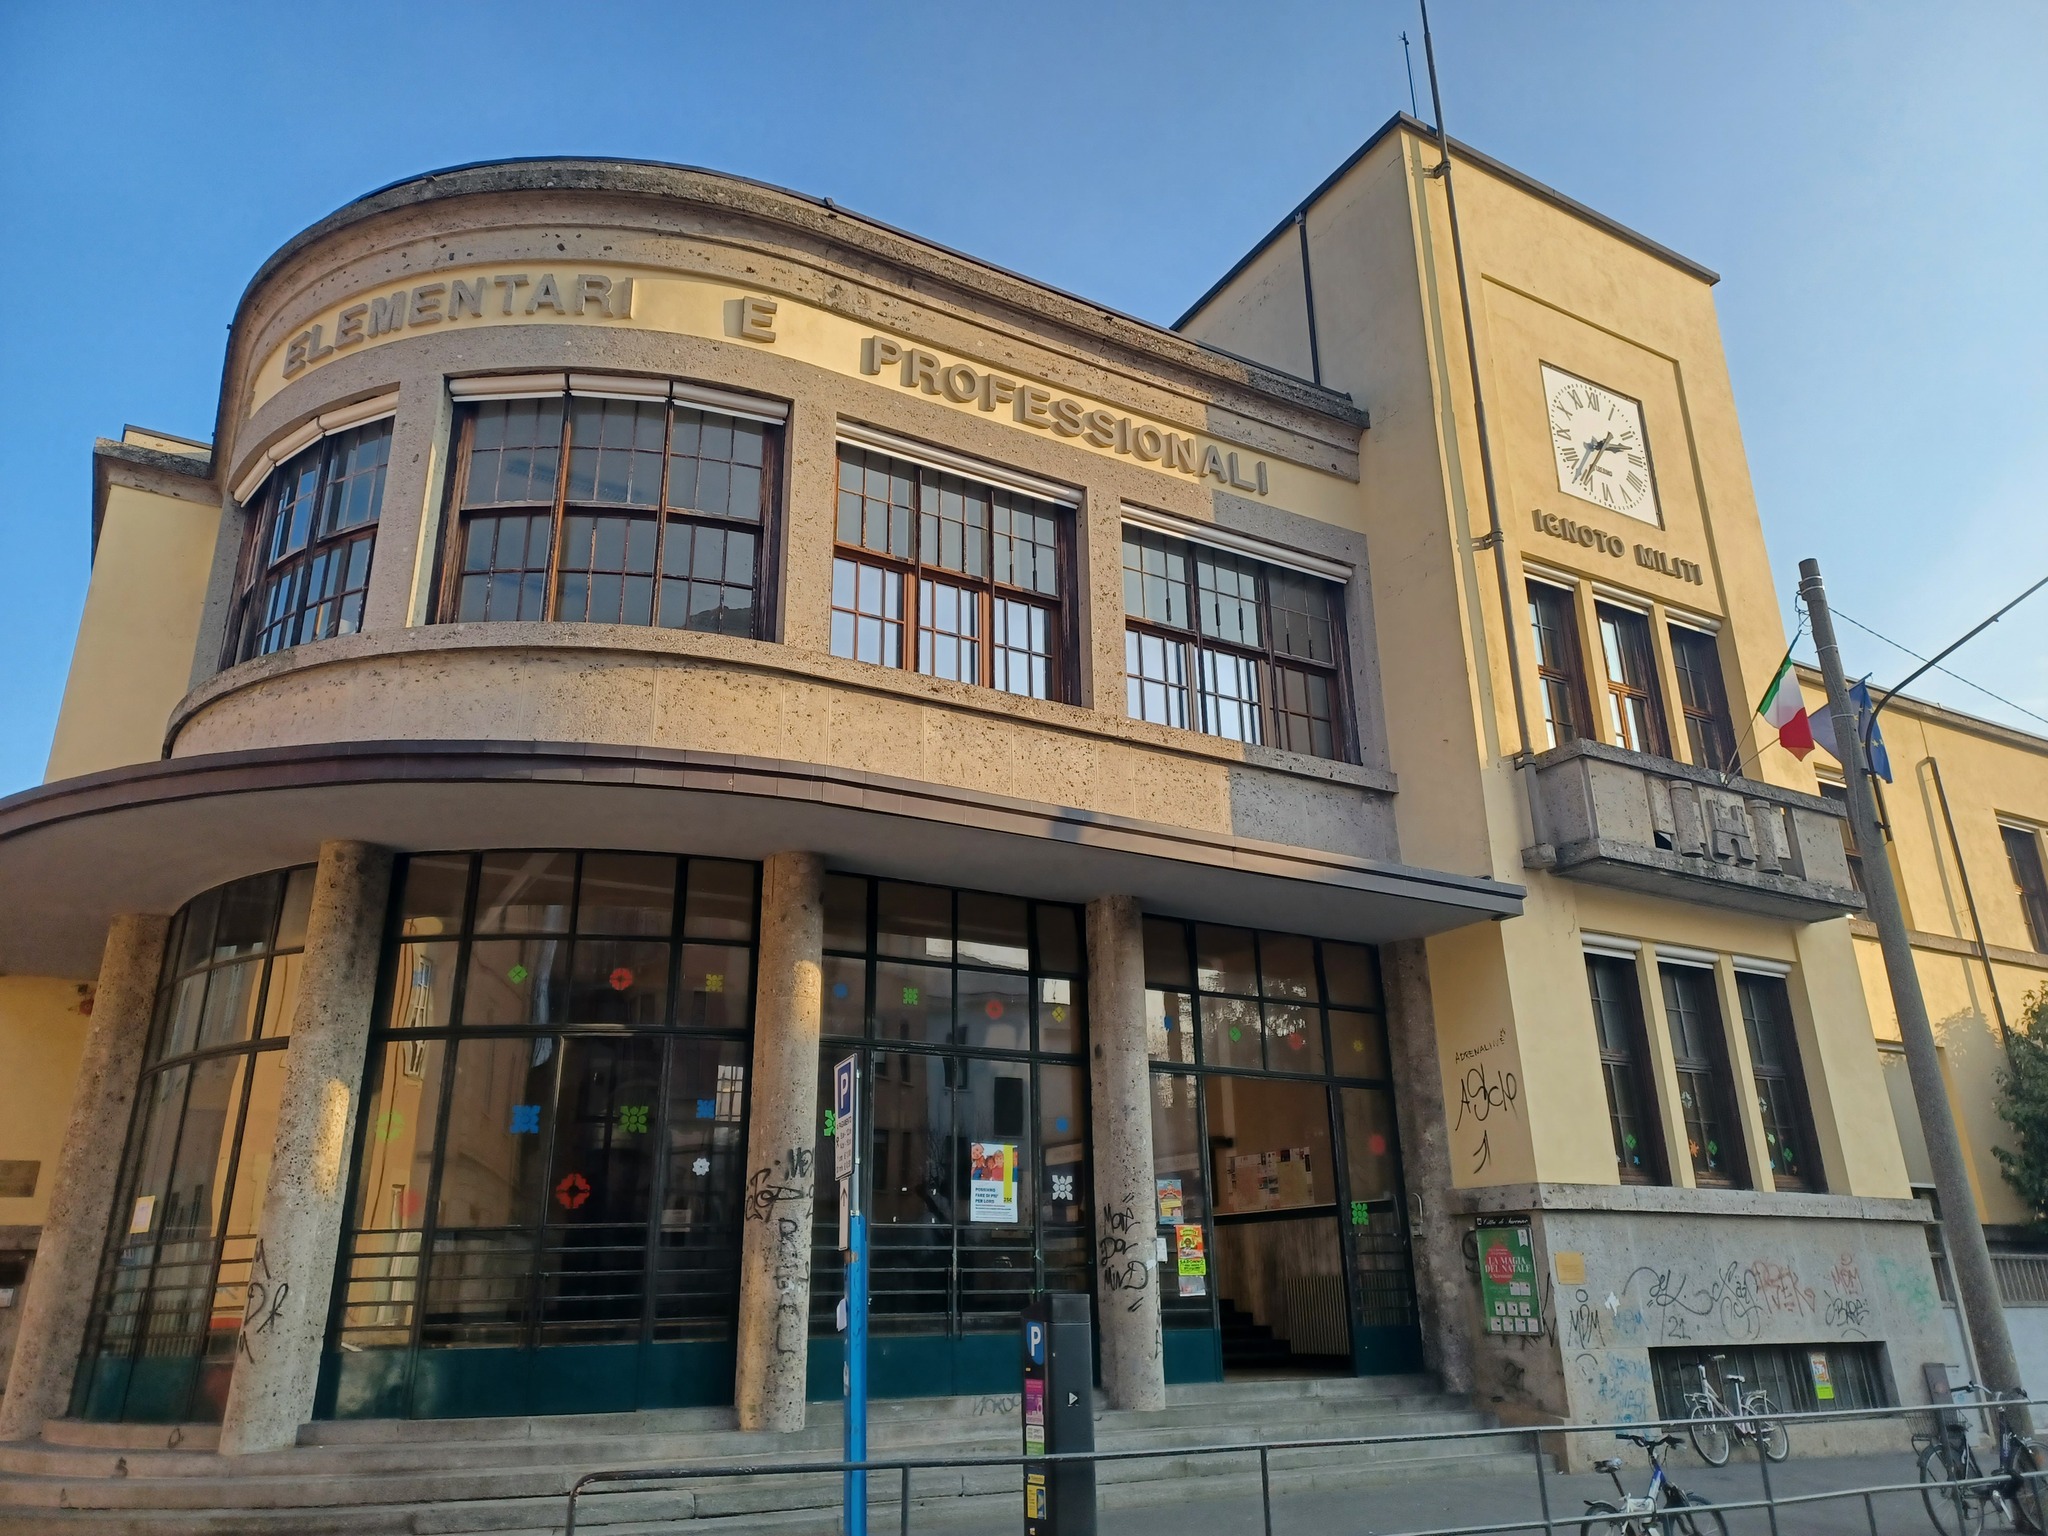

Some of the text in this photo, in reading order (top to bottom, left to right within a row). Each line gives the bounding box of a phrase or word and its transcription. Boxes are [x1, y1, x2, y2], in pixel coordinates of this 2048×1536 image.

[282, 272, 1269, 496] ELEMENTARI E PROFESSIONALI
[1532, 509, 1704, 586] IGNOTO MILITI
[840, 1072, 849, 1110] P
[1485, 1264, 1532, 1273] DEL NATALE
[1488, 1256, 1526, 1265] LA MAGIA
[1030, 1326, 1041, 1357] P
